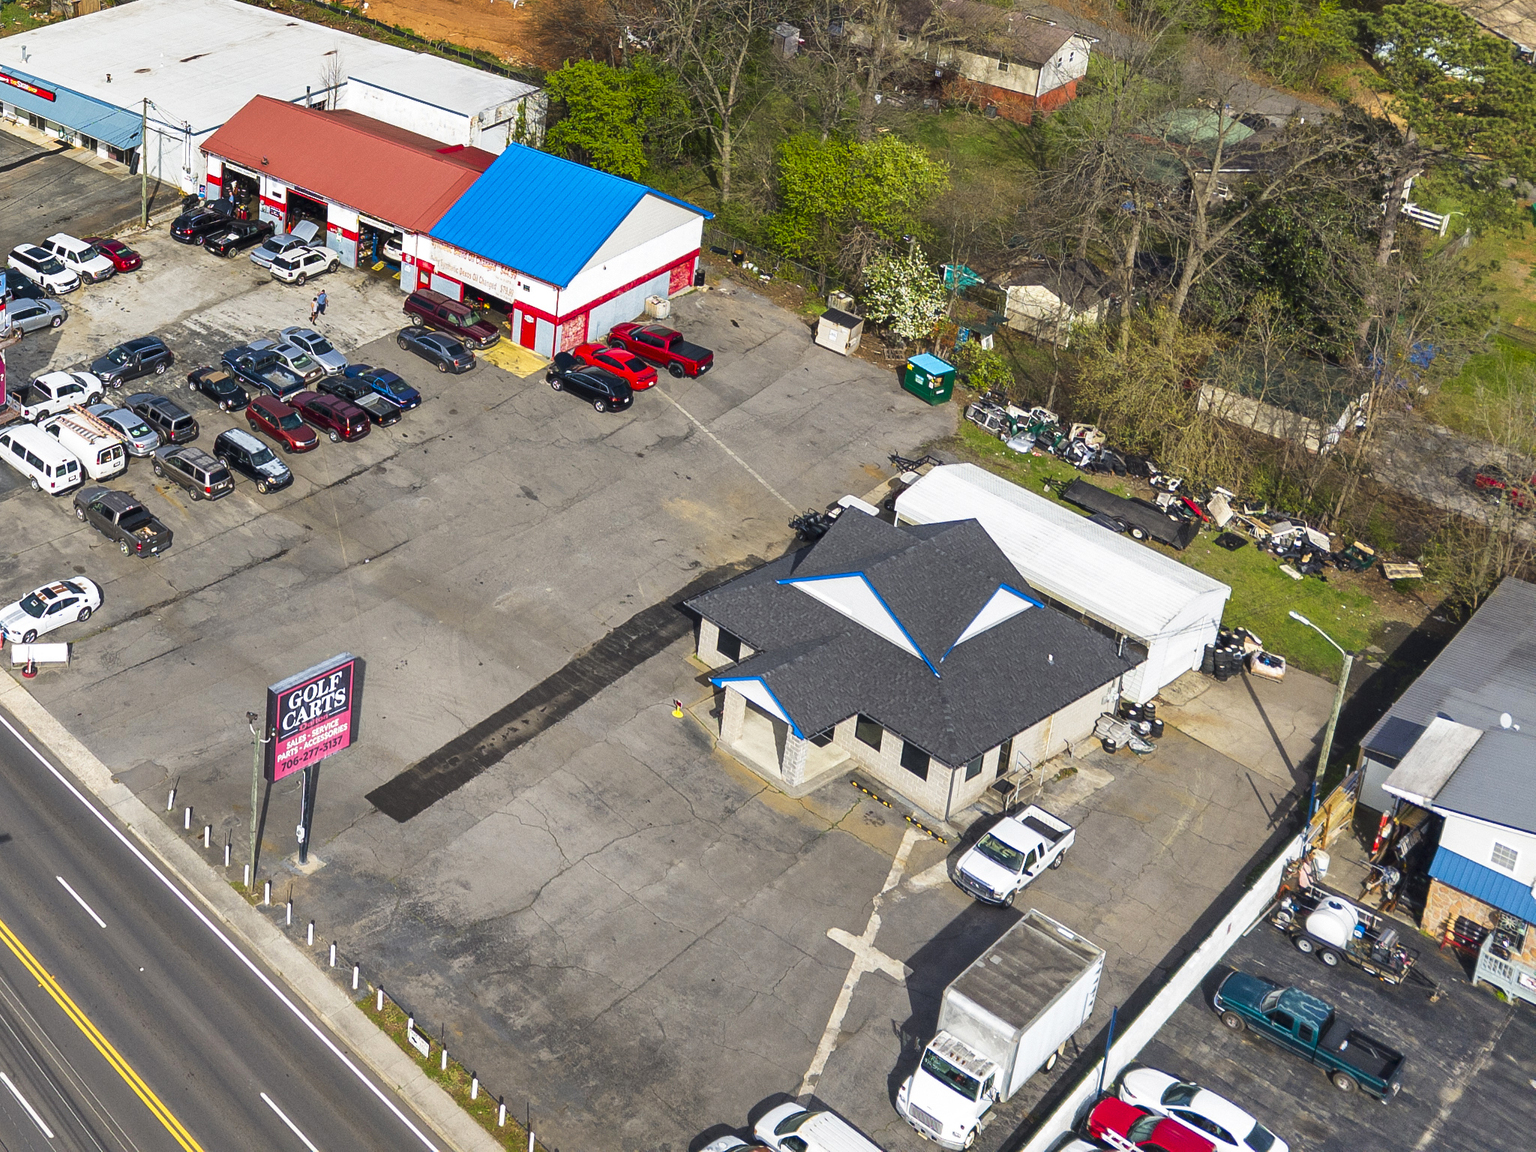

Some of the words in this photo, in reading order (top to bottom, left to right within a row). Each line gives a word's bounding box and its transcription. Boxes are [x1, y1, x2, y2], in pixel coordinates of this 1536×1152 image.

[288, 670, 343, 710] GOLF
[282, 687, 346, 731] CARTS
[299, 714, 329, 731] Dalton
[277, 747, 299, 763] PARTS
[303, 723, 348, 750] ACCESSORIES
[286, 733, 307, 750] SALES
[311, 718, 340, 737] SERVICE
[281, 736, 343, 771] 706-277-3137
